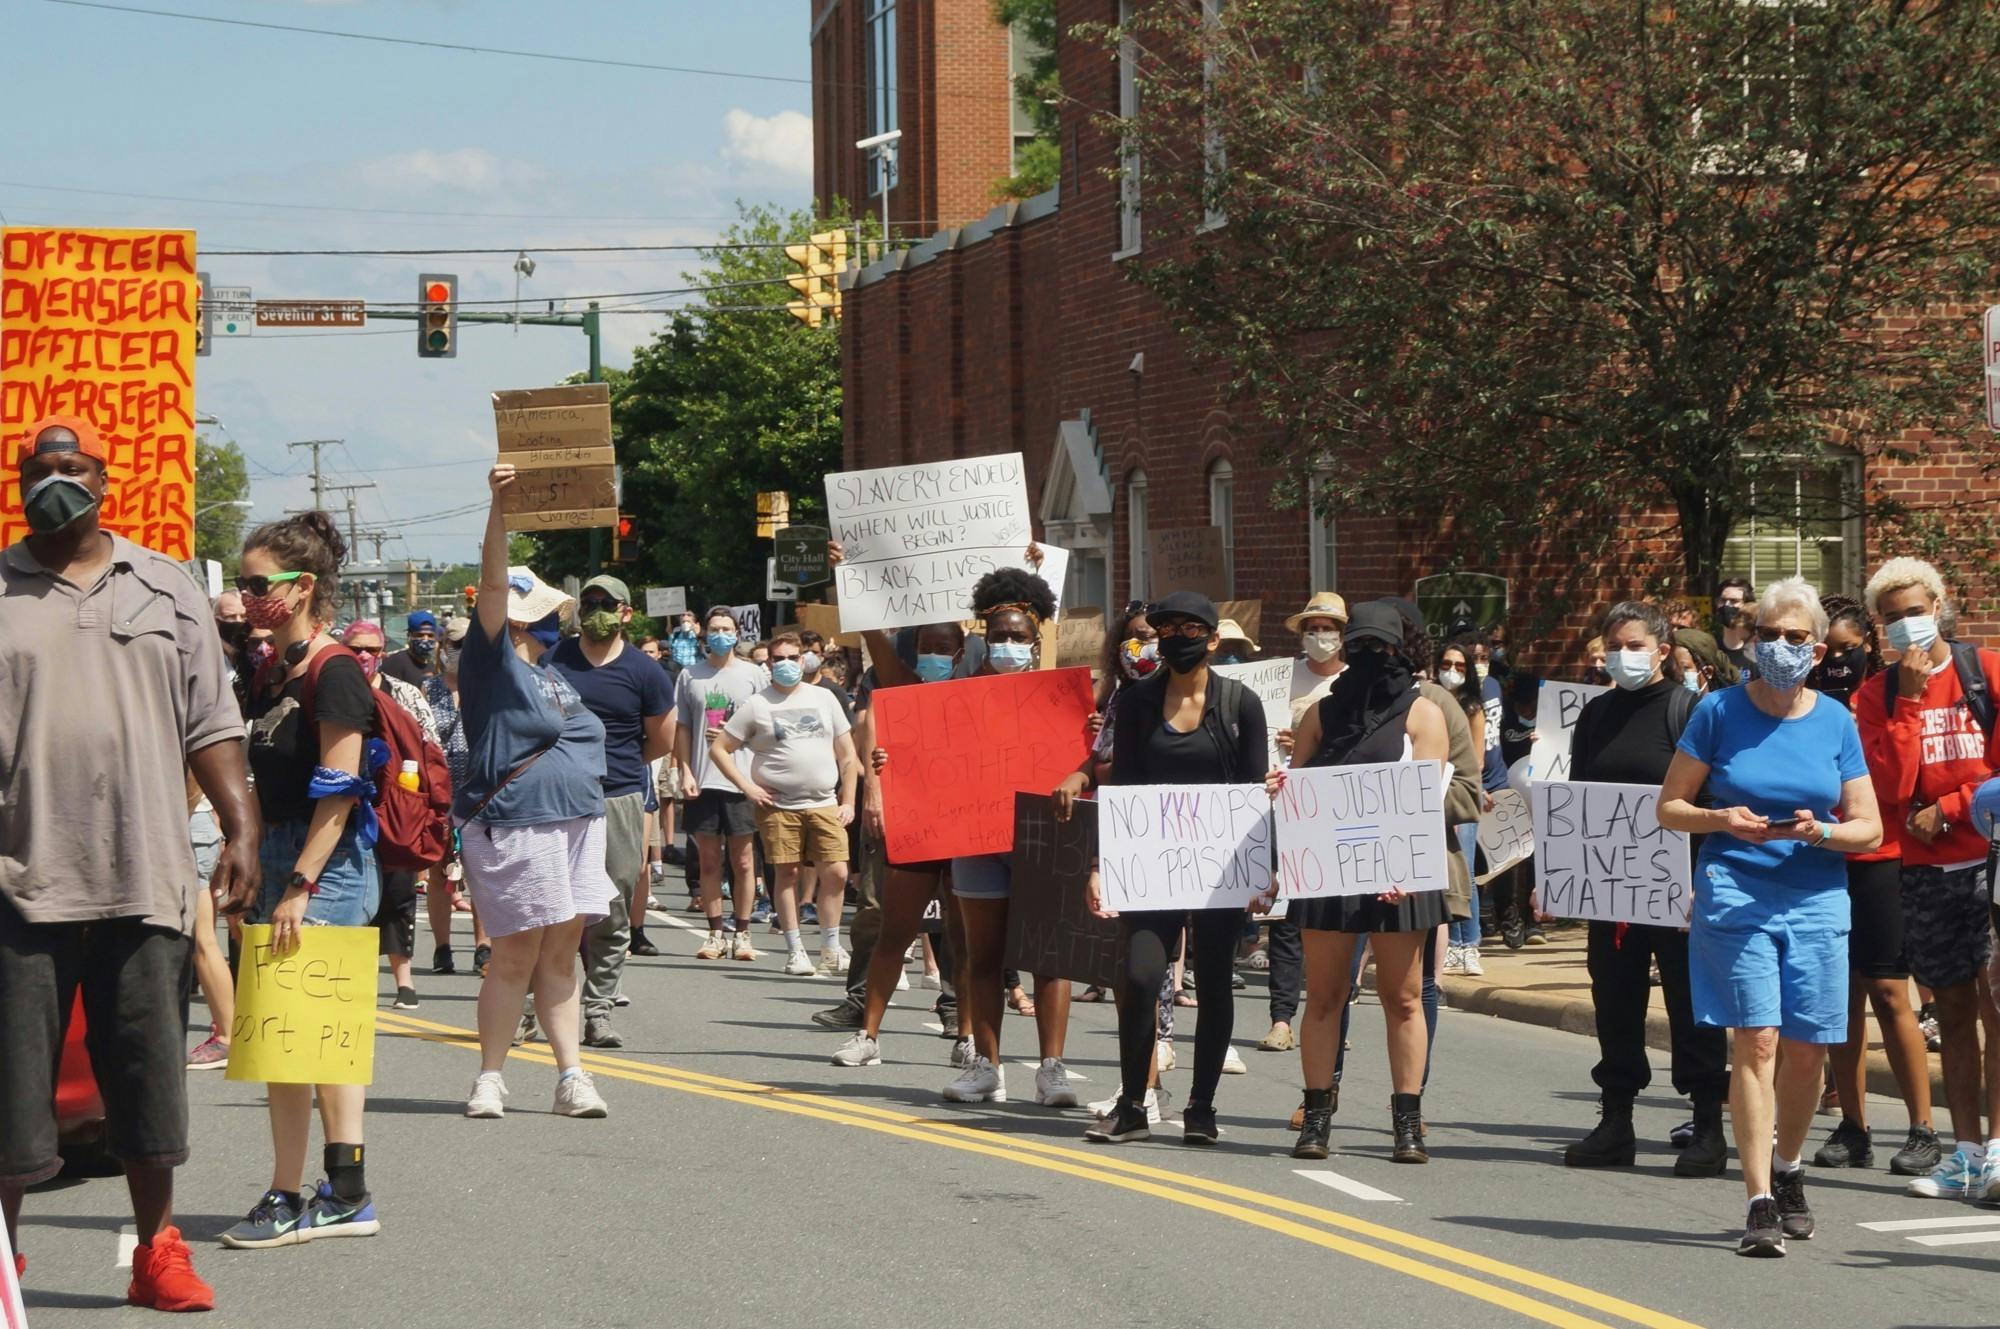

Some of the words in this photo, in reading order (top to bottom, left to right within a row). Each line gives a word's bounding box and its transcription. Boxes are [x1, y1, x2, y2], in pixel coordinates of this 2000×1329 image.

[1, 230, 195, 275] OFFICER
[1, 278, 192, 325] OVERSEER
[260, 305, 315, 321] Seventh
[321, 306, 336, 321] St
[342, 305, 360, 321] NE
[0, 329, 191, 387] OFFICER
[0, 374, 195, 433] OVERSEER
[1, 432, 193, 484] OCER
[530, 449, 563, 463] Black
[835, 468, 941, 511] SLAVERY
[949, 458, 1020, 493] ENDED!
[840, 514, 897, 543] WHEN
[907, 509, 953, 531] WILL
[959, 500, 1015, 523] JUSTICE
[781, 554, 800, 565] City
[803, 553, 825, 563] Hall
[783, 564, 823, 573] Entrance
[843, 562, 922, 599] BLACK
[932, 554, 998, 584] LIVES
[739, 609, 761, 633] ACK
[883, 588, 971, 621] MATTE
[883, 678, 1064, 752] BLACK
[1108, 793, 1150, 840] NO
[1281, 776, 1319, 823] NO
[1332, 763, 1441, 821] JUSTICE
[1103, 851, 1148, 906] NO
[1157, 845, 1272, 897] PRISONS
[1281, 848, 1324, 896] NO
[1335, 833, 1433, 888] PEACE
[1543, 840, 1673, 883] LIVES
[1542, 874, 1691, 921] MATTER
[254, 943, 353, 1002] Feet
